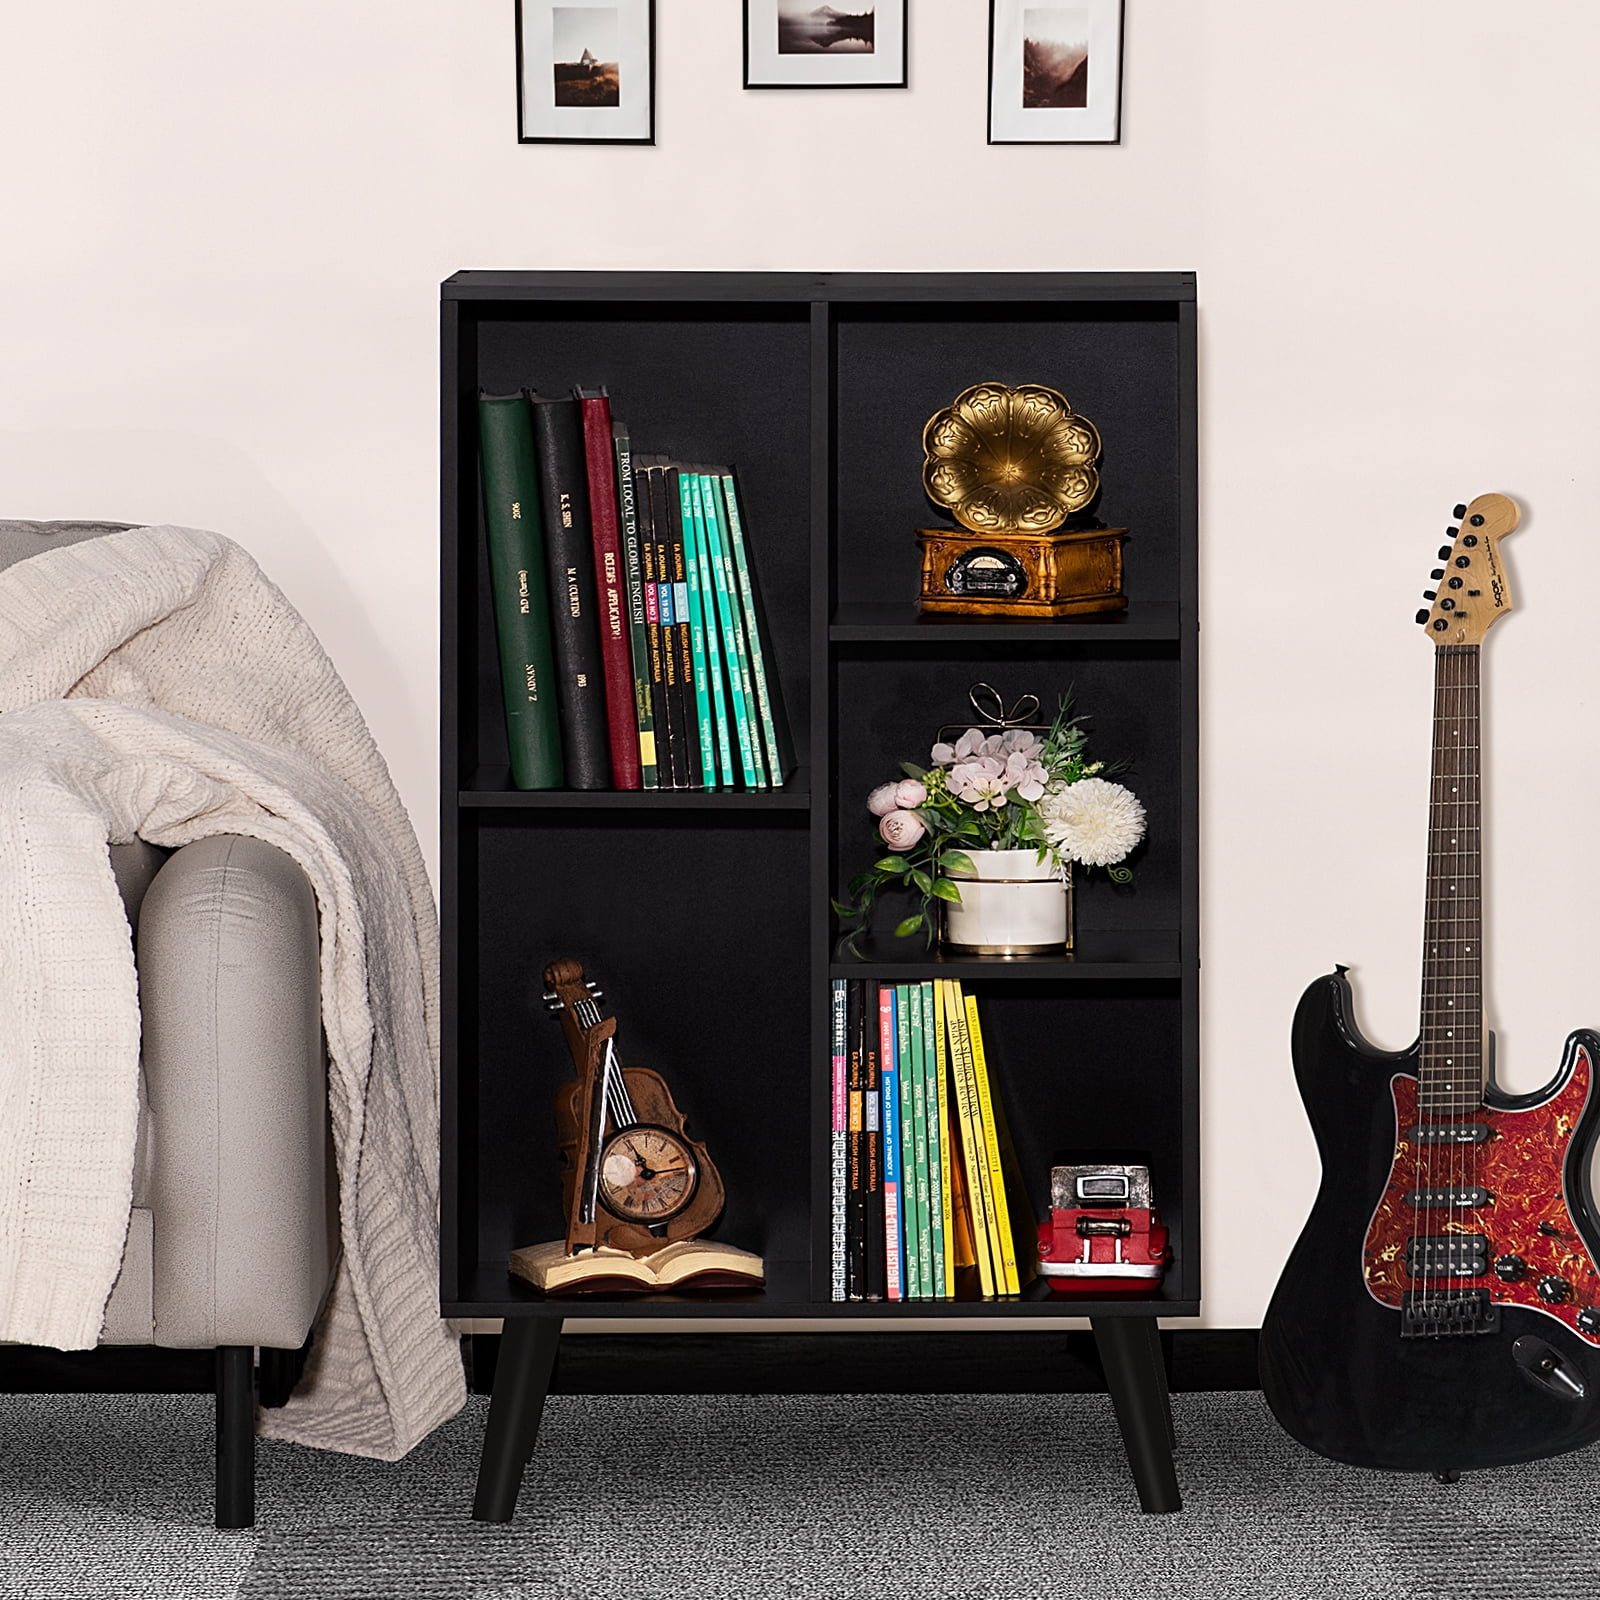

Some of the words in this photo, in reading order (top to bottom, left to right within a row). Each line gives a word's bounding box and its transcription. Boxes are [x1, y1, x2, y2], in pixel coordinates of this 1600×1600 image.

[621, 452, 631, 480] FROM
[512, 503, 521, 519] 2006
[623, 484, 634, 518] LOCAL
[726, 492, 735, 511] Asian
[626, 520, 636, 534] TO
[628, 537, 639, 577] GLOBAL
[674, 544, 680, 552] EA
[520, 599, 529, 613] PhD
[563, 511, 572, 527] SHIN
[569, 585, 580, 617] (CURTIN)
[577, 674, 586, 687] 1993
[632, 581, 643, 623] ENGLISH
[650, 606, 656, 615] NO
[663, 608, 669, 617] NO
[526, 665, 536, 691] ADNAN
[701, 719, 711, 751] Englishes
[738, 718, 750, 750] Englishes
[744, 751, 753, 770] Asian
[899, 1000, 907, 1019] Asian
[924, 997, 932, 1017] Asian
[899, 1021, 909, 1054] Englishes
[924, 1018, 934, 1050] Englishes
[852, 1115, 858, 1124] NO
[869, 1115, 876, 1124] NO
[886, 1192, 898, 1248] WORLD-WIDE
[920, 1229, 930, 1261] Englishes
[887, 1250, 899, 1288] ENGLISH
